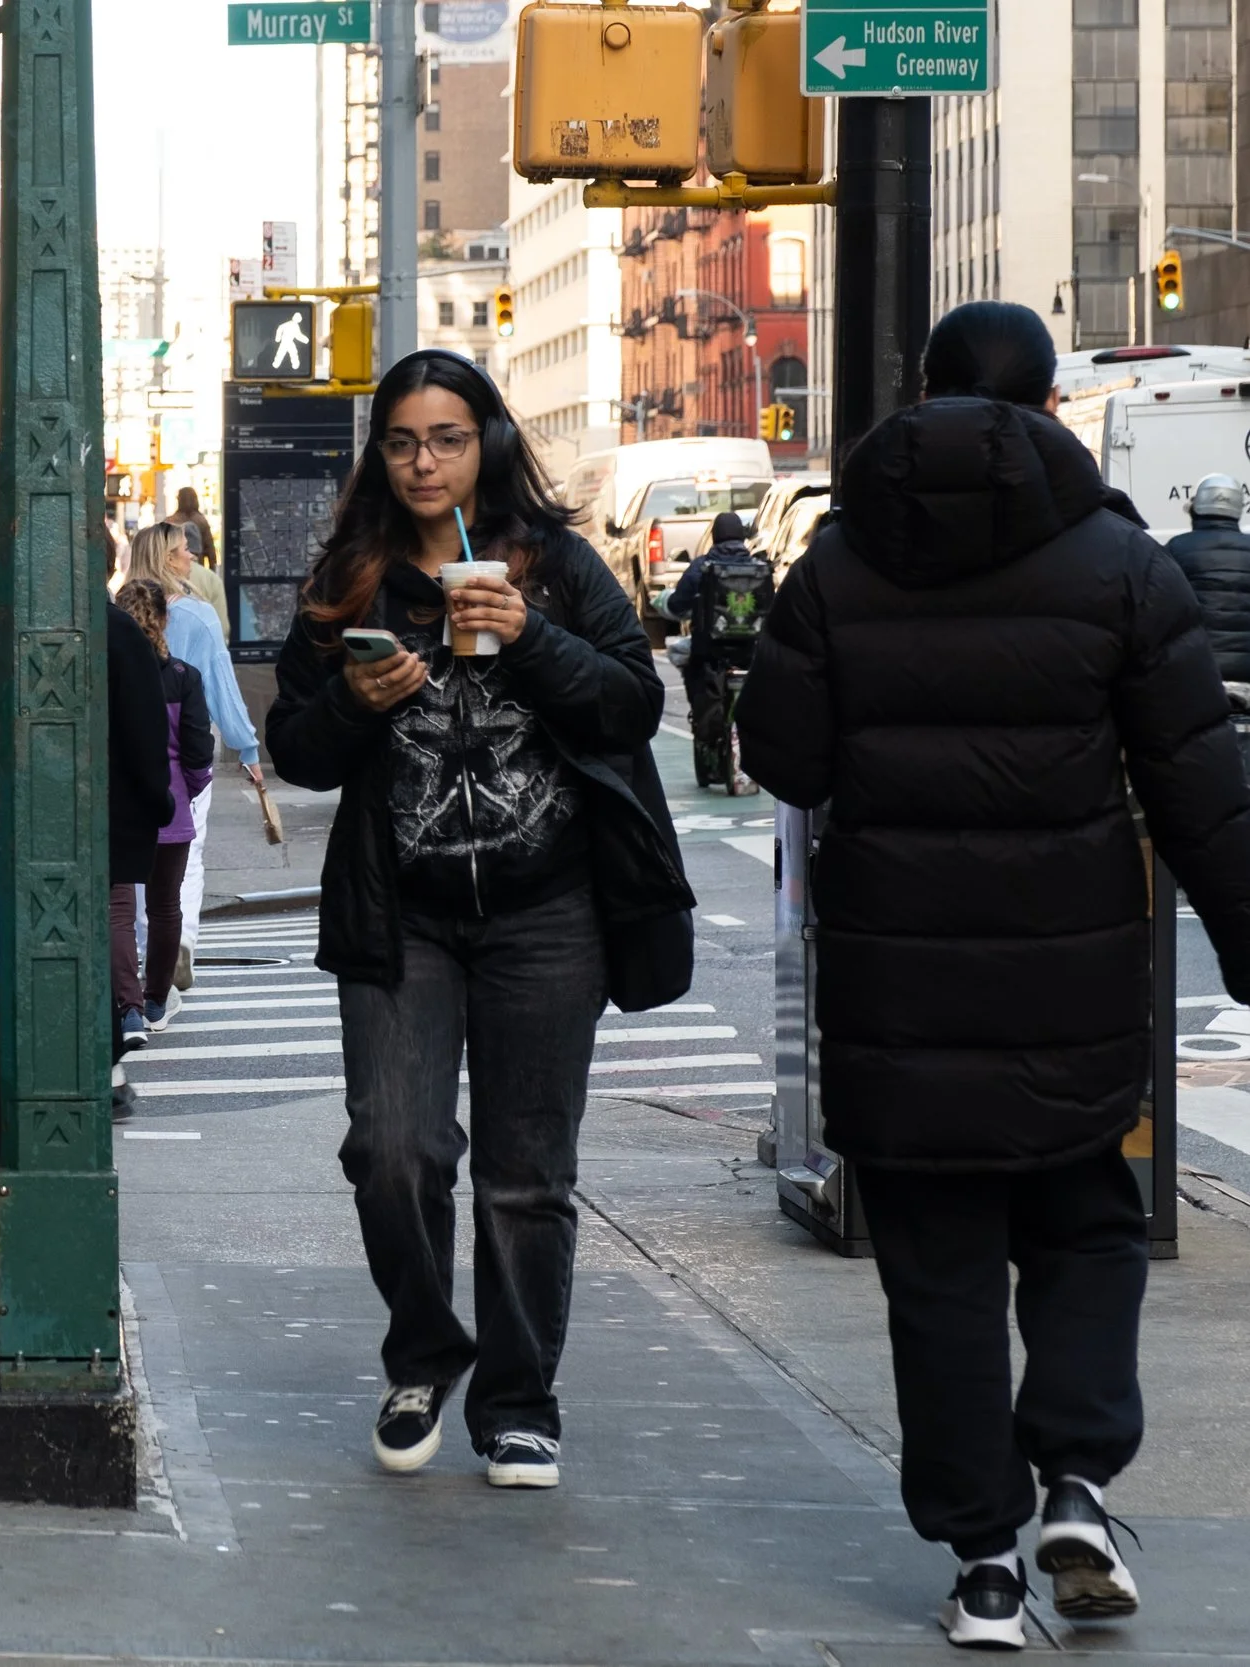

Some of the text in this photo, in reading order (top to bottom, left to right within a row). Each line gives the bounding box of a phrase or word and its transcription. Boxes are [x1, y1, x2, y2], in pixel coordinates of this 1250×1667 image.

[247, 6, 353, 42] Murray St
[863, 20, 979, 44] Hudson River
[896, 52, 979, 81] Greenway
